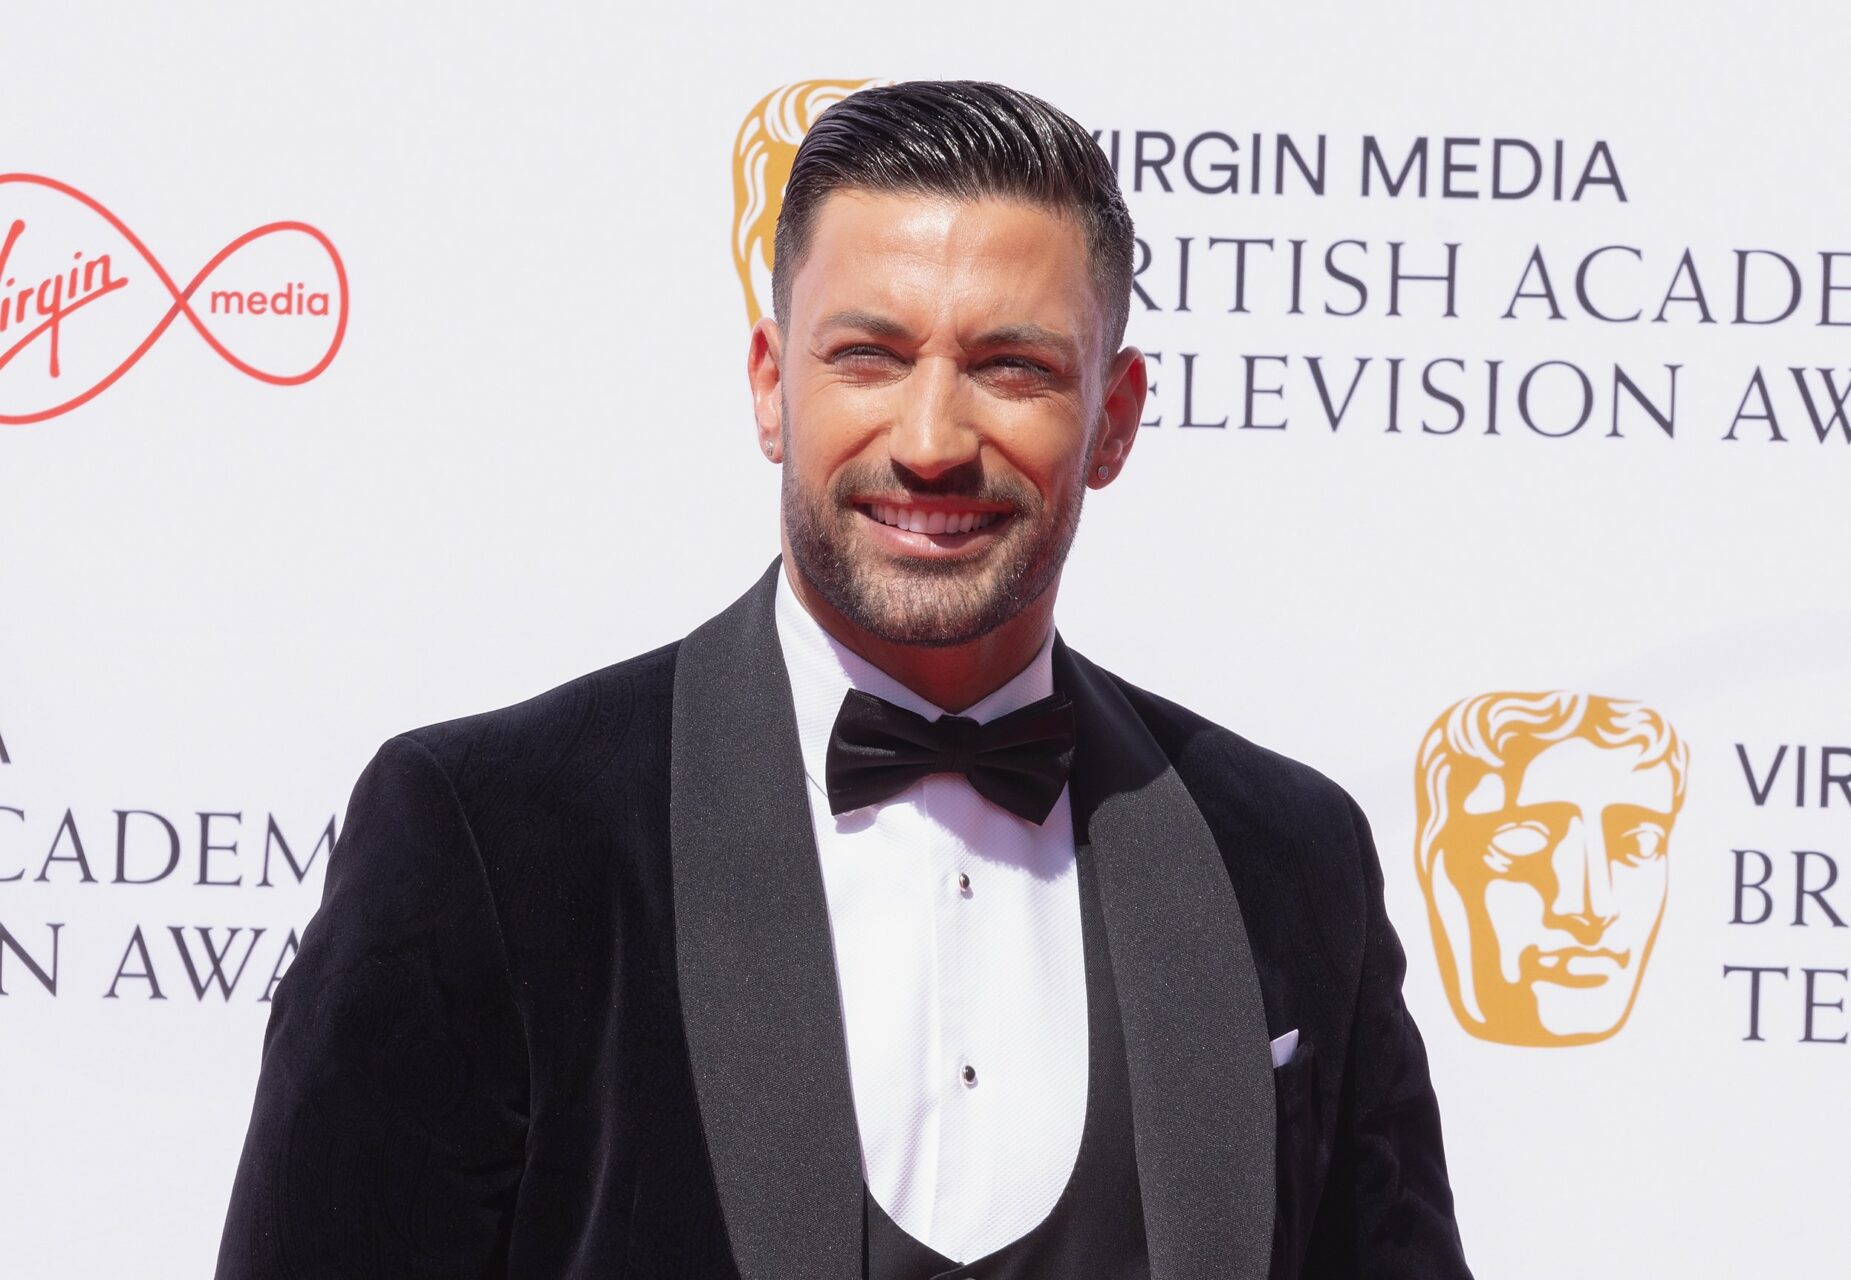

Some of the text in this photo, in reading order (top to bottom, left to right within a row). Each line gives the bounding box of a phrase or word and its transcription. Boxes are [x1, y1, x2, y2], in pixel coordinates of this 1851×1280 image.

[1361, 135, 1628, 202] MEDIA
[210, 282, 330, 316] media
[1501, 243, 1851, 327] ACADE
[1734, 743, 1851, 808] VIR
[1728, 849, 1850, 928] BR
[1723, 965, 1849, 1045] TE
